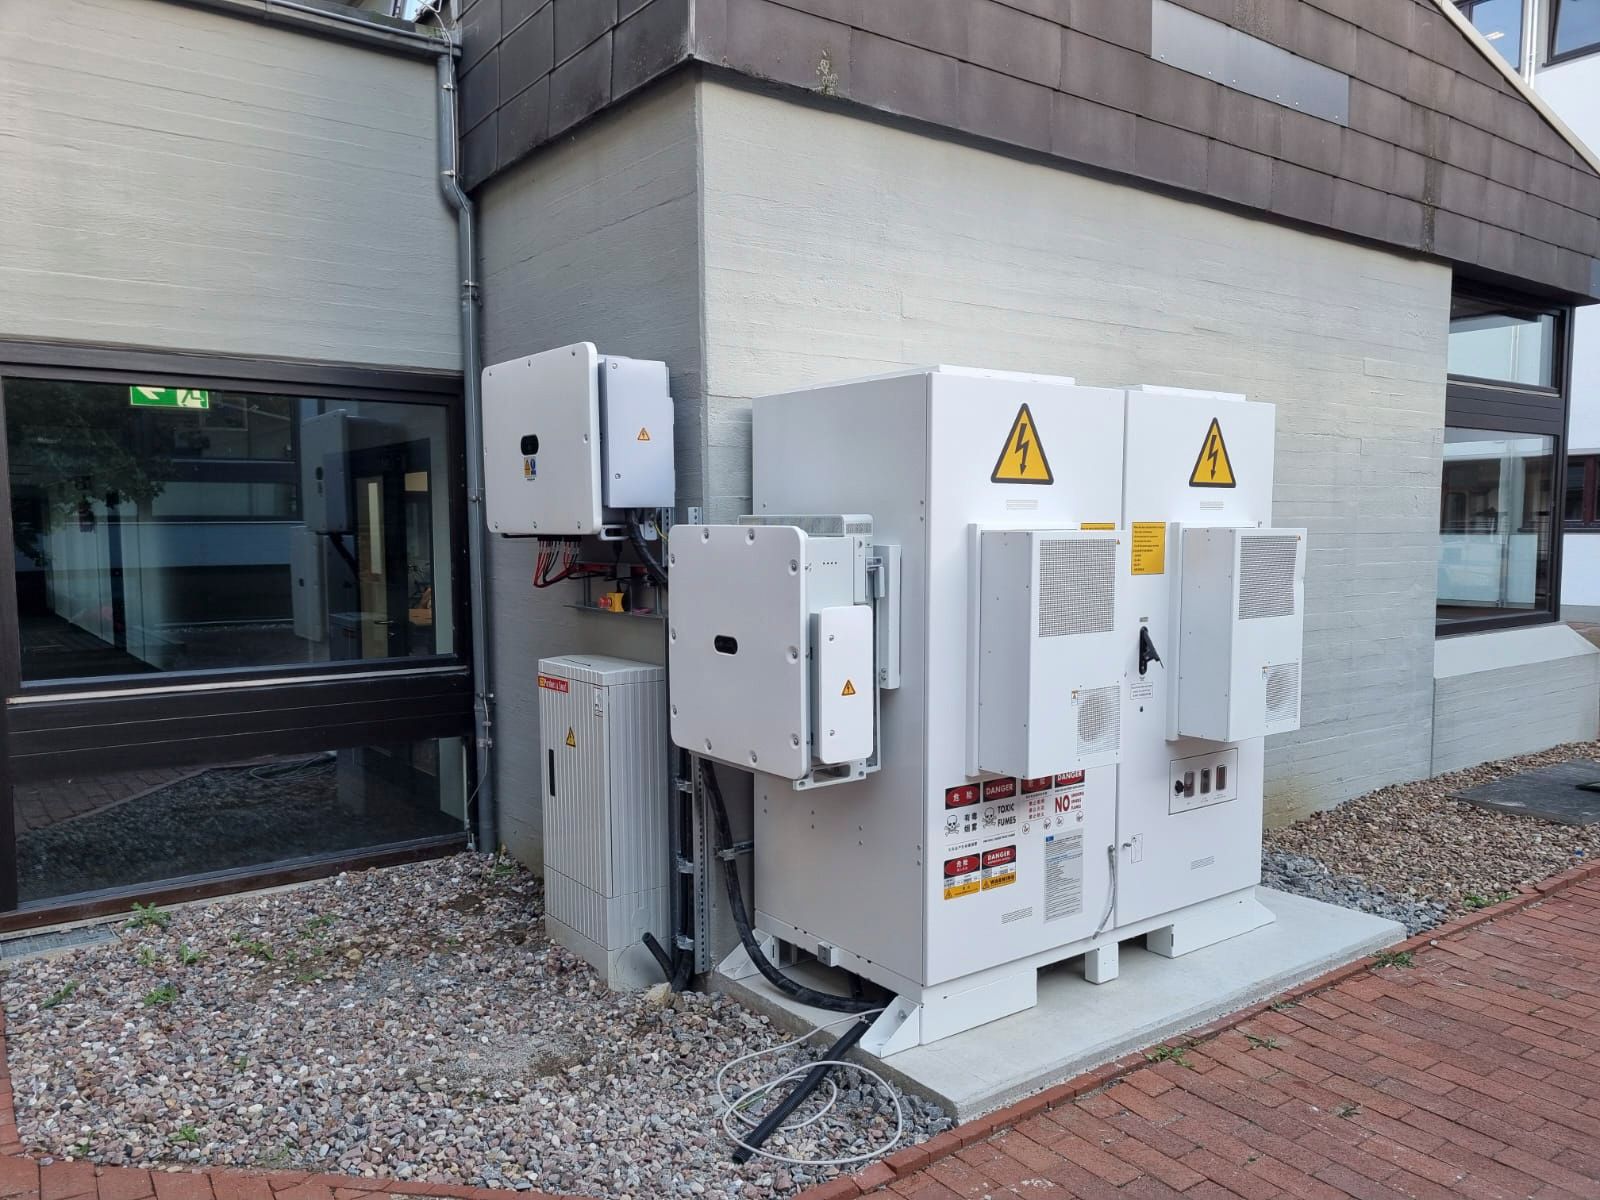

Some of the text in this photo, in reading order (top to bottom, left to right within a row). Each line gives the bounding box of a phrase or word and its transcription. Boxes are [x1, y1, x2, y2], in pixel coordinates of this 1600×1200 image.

[985, 783, 1013, 795] DANGER
[997, 802, 1015, 814] TOXIC
[1055, 795, 1070, 813] NO
[997, 816, 1016, 827] FUMES
[987, 850, 1011, 861] DANGER
[991, 874, 1015, 884] WARNING
